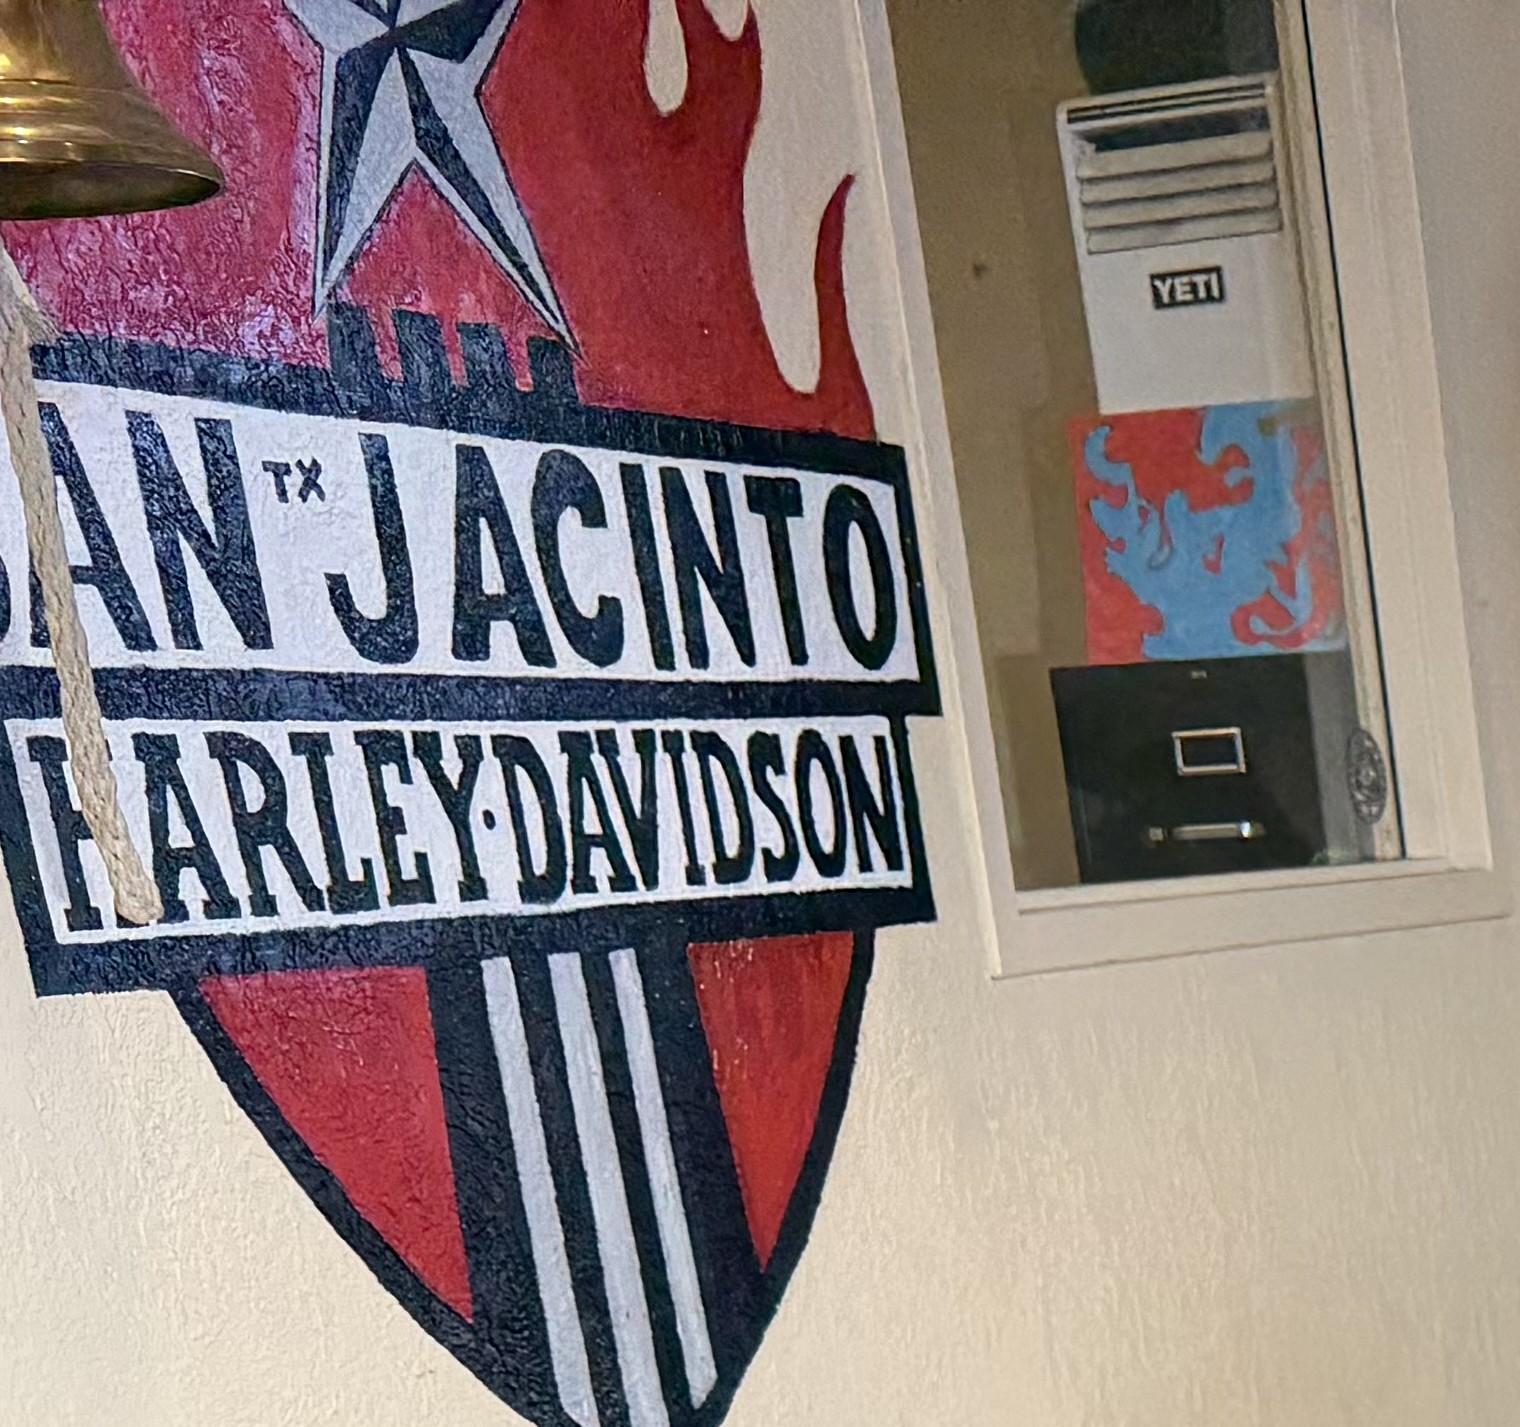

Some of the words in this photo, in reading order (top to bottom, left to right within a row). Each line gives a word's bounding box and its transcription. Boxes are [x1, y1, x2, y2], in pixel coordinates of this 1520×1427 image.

[1153, 271, 1220, 304] YETI
[262, 456, 325, 504] TX
[0, 400, 275, 652] AN
[323, 432, 899, 670] JACINTO
